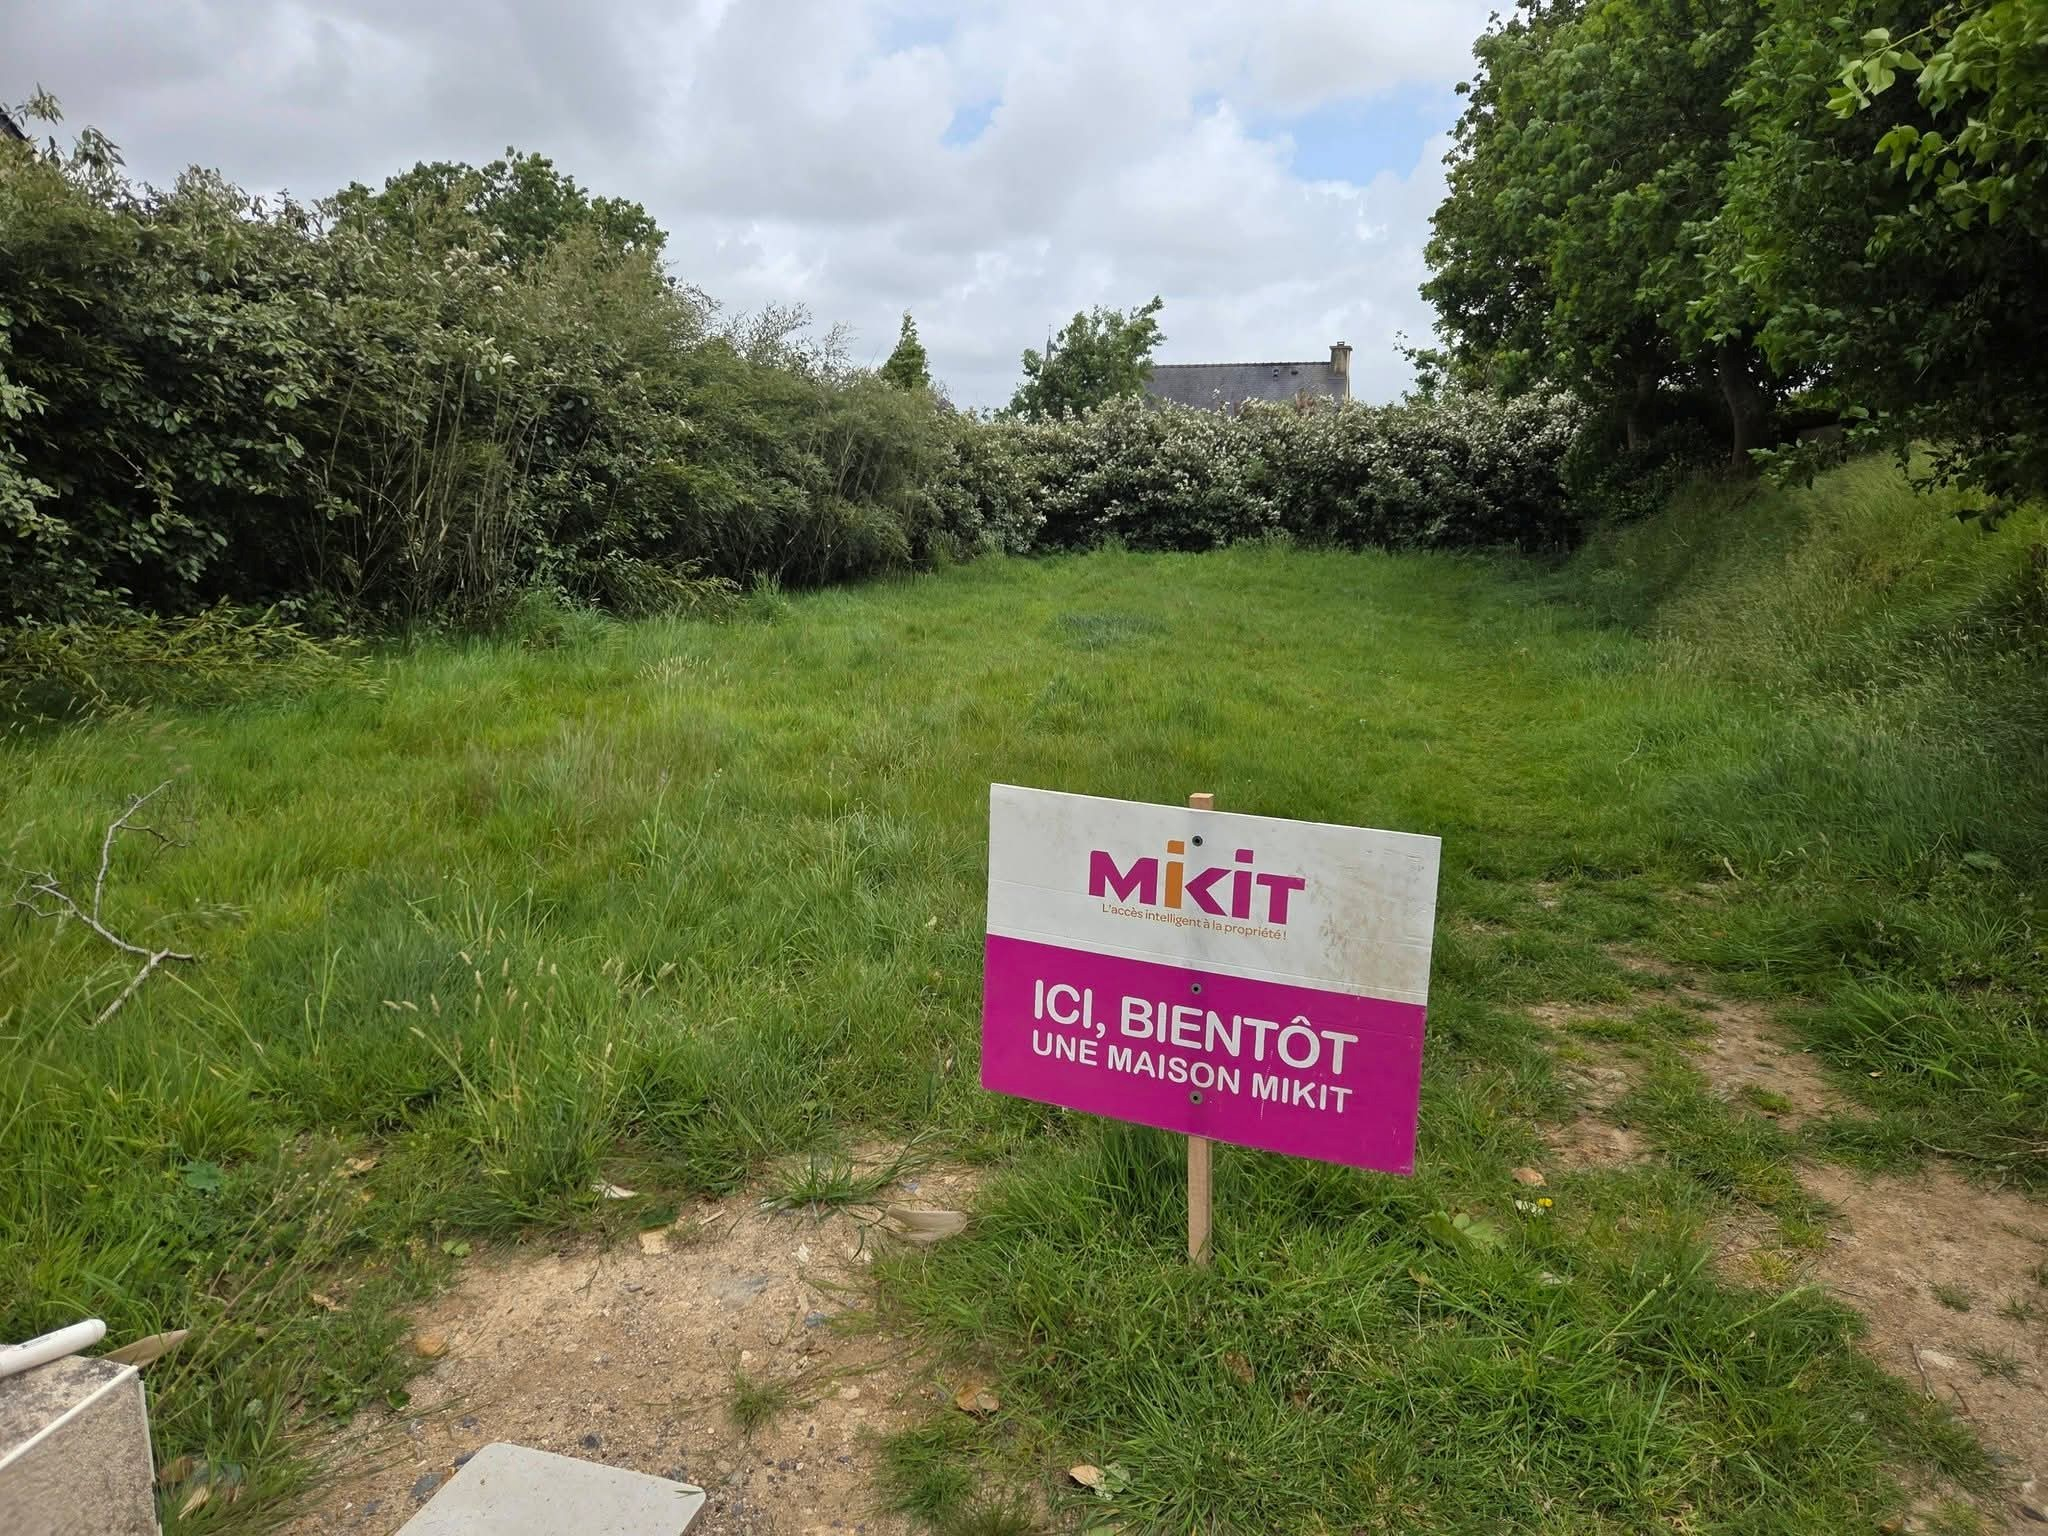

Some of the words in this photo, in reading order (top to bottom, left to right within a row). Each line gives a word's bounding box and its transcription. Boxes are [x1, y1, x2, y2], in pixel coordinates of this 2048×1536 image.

[1102, 903, 1144, 919] L'accès
[1145, 909, 1202, 928] intelligent
[1203, 918, 1210, 930] à
[1212, 919, 1222, 932] la
[1033, 979, 1106, 1039] ICI,
[1120, 995, 1359, 1075] BIENTÔT
[1032, 1030, 1099, 1067] UNE
[1107, 1045, 1240, 1095] MAISON
[1252, 1072, 1353, 1114] MIKIT
